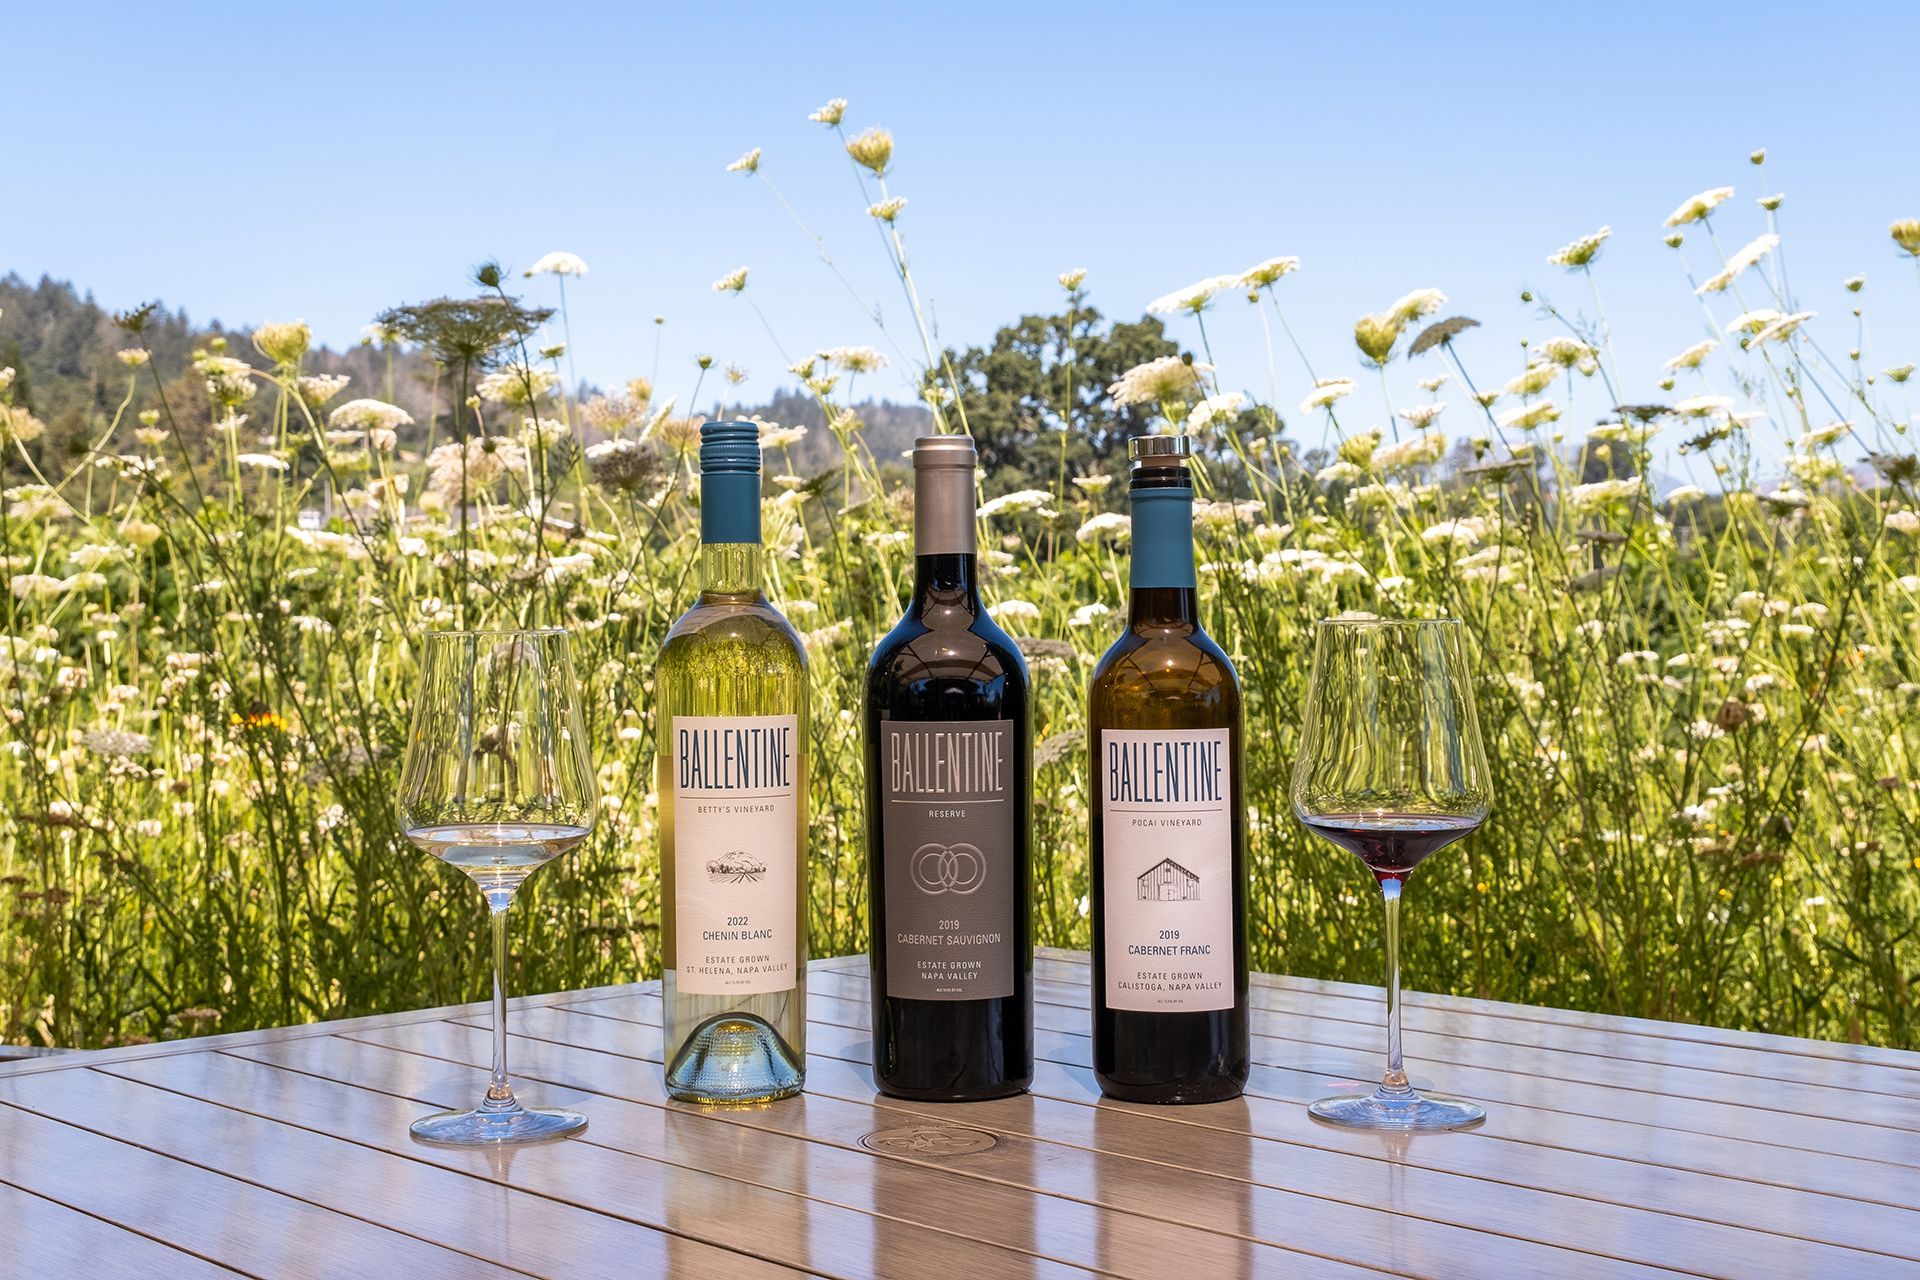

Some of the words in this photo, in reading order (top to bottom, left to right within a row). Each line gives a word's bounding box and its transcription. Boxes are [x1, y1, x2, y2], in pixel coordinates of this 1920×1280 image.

[680, 727, 790, 789] BALLENTINE
[891, 732, 1003, 793] BALLENTINE
[1109, 740, 1222, 802] BALLENTINE
[697, 805, 731, 814] BETTY'S
[734, 804, 775, 813] VINEYARD
[928, 810, 967, 818] RESERVE
[1132, 819, 1157, 827] POCAI
[1160, 818, 1202, 827] VINEYARD
[727, 916, 749, 926] 2022
[938, 919, 960, 930] 2019
[702, 930, 738, 941] CHENIN
[741, 929, 773, 940] BLANC
[897, 933, 944, 945] CABERNET
[946, 933, 1001, 945] SAUVIGNON
[1159, 930, 1180, 940] 2019
[1128, 944, 1177, 956] CABERNET
[1180, 944, 1211, 955] FRANC
[705, 956, 735, 964] ESTATE
[739, 954, 770, 963] GROWN
[699, 967, 734, 975] HELENA,
[762, 963, 788, 973] VALLEY
[917, 961, 947, 969] ESTATE
[950, 961, 982, 969] GROWN
[921, 972, 944, 980] NAPA
[947, 971, 978, 980] VALLEY
[1137, 972, 1167, 980] ESTATE
[1171, 971, 1203, 980] GROWN
[1117, 981, 1166, 992] CALISTOGA,
[1168, 983, 1192, 991] NAPA
[1194, 981, 1222, 990] VALLEY
